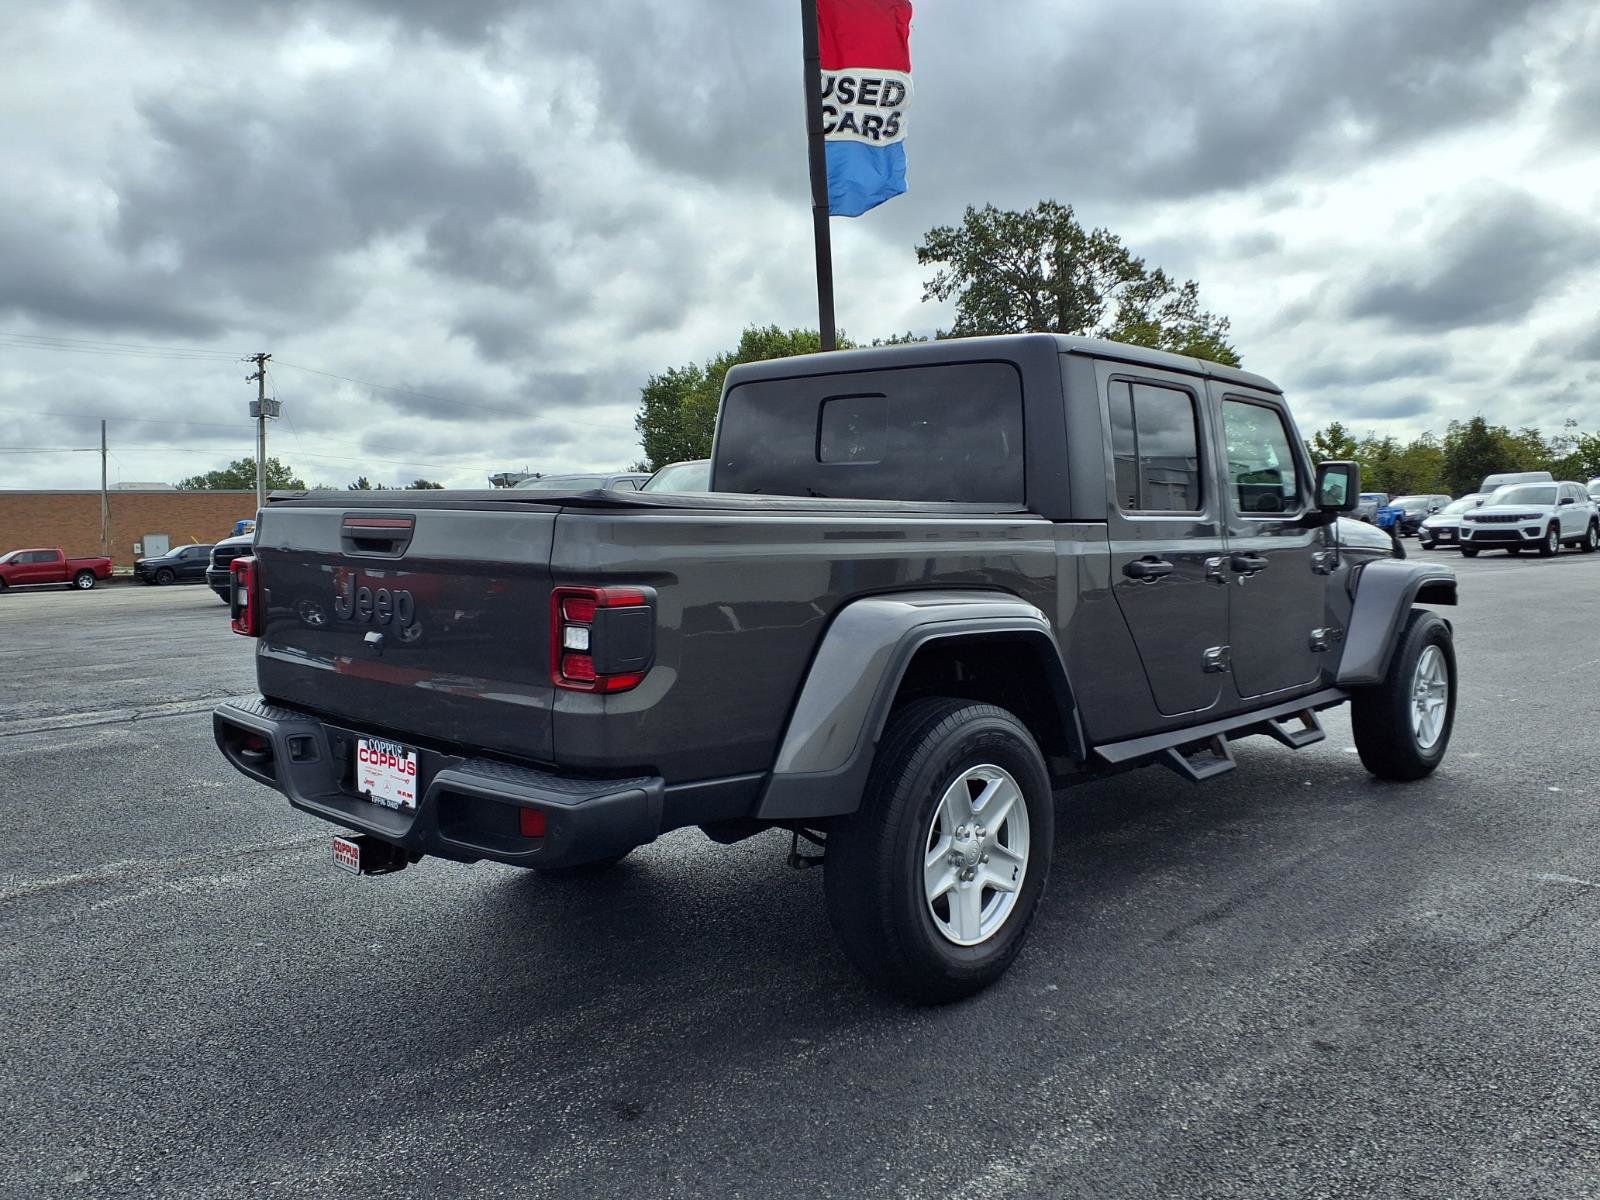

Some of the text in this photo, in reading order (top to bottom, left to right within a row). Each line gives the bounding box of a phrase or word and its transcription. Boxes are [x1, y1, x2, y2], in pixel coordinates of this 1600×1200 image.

[823, 104, 902, 140] CARS
[334, 572, 415, 636] Jeep
[368, 738, 403, 758] COPPUS
[359, 748, 416, 776] COPPUS
[397, 789, 413, 799] RAM
[333, 839, 359, 860] COPPUS
